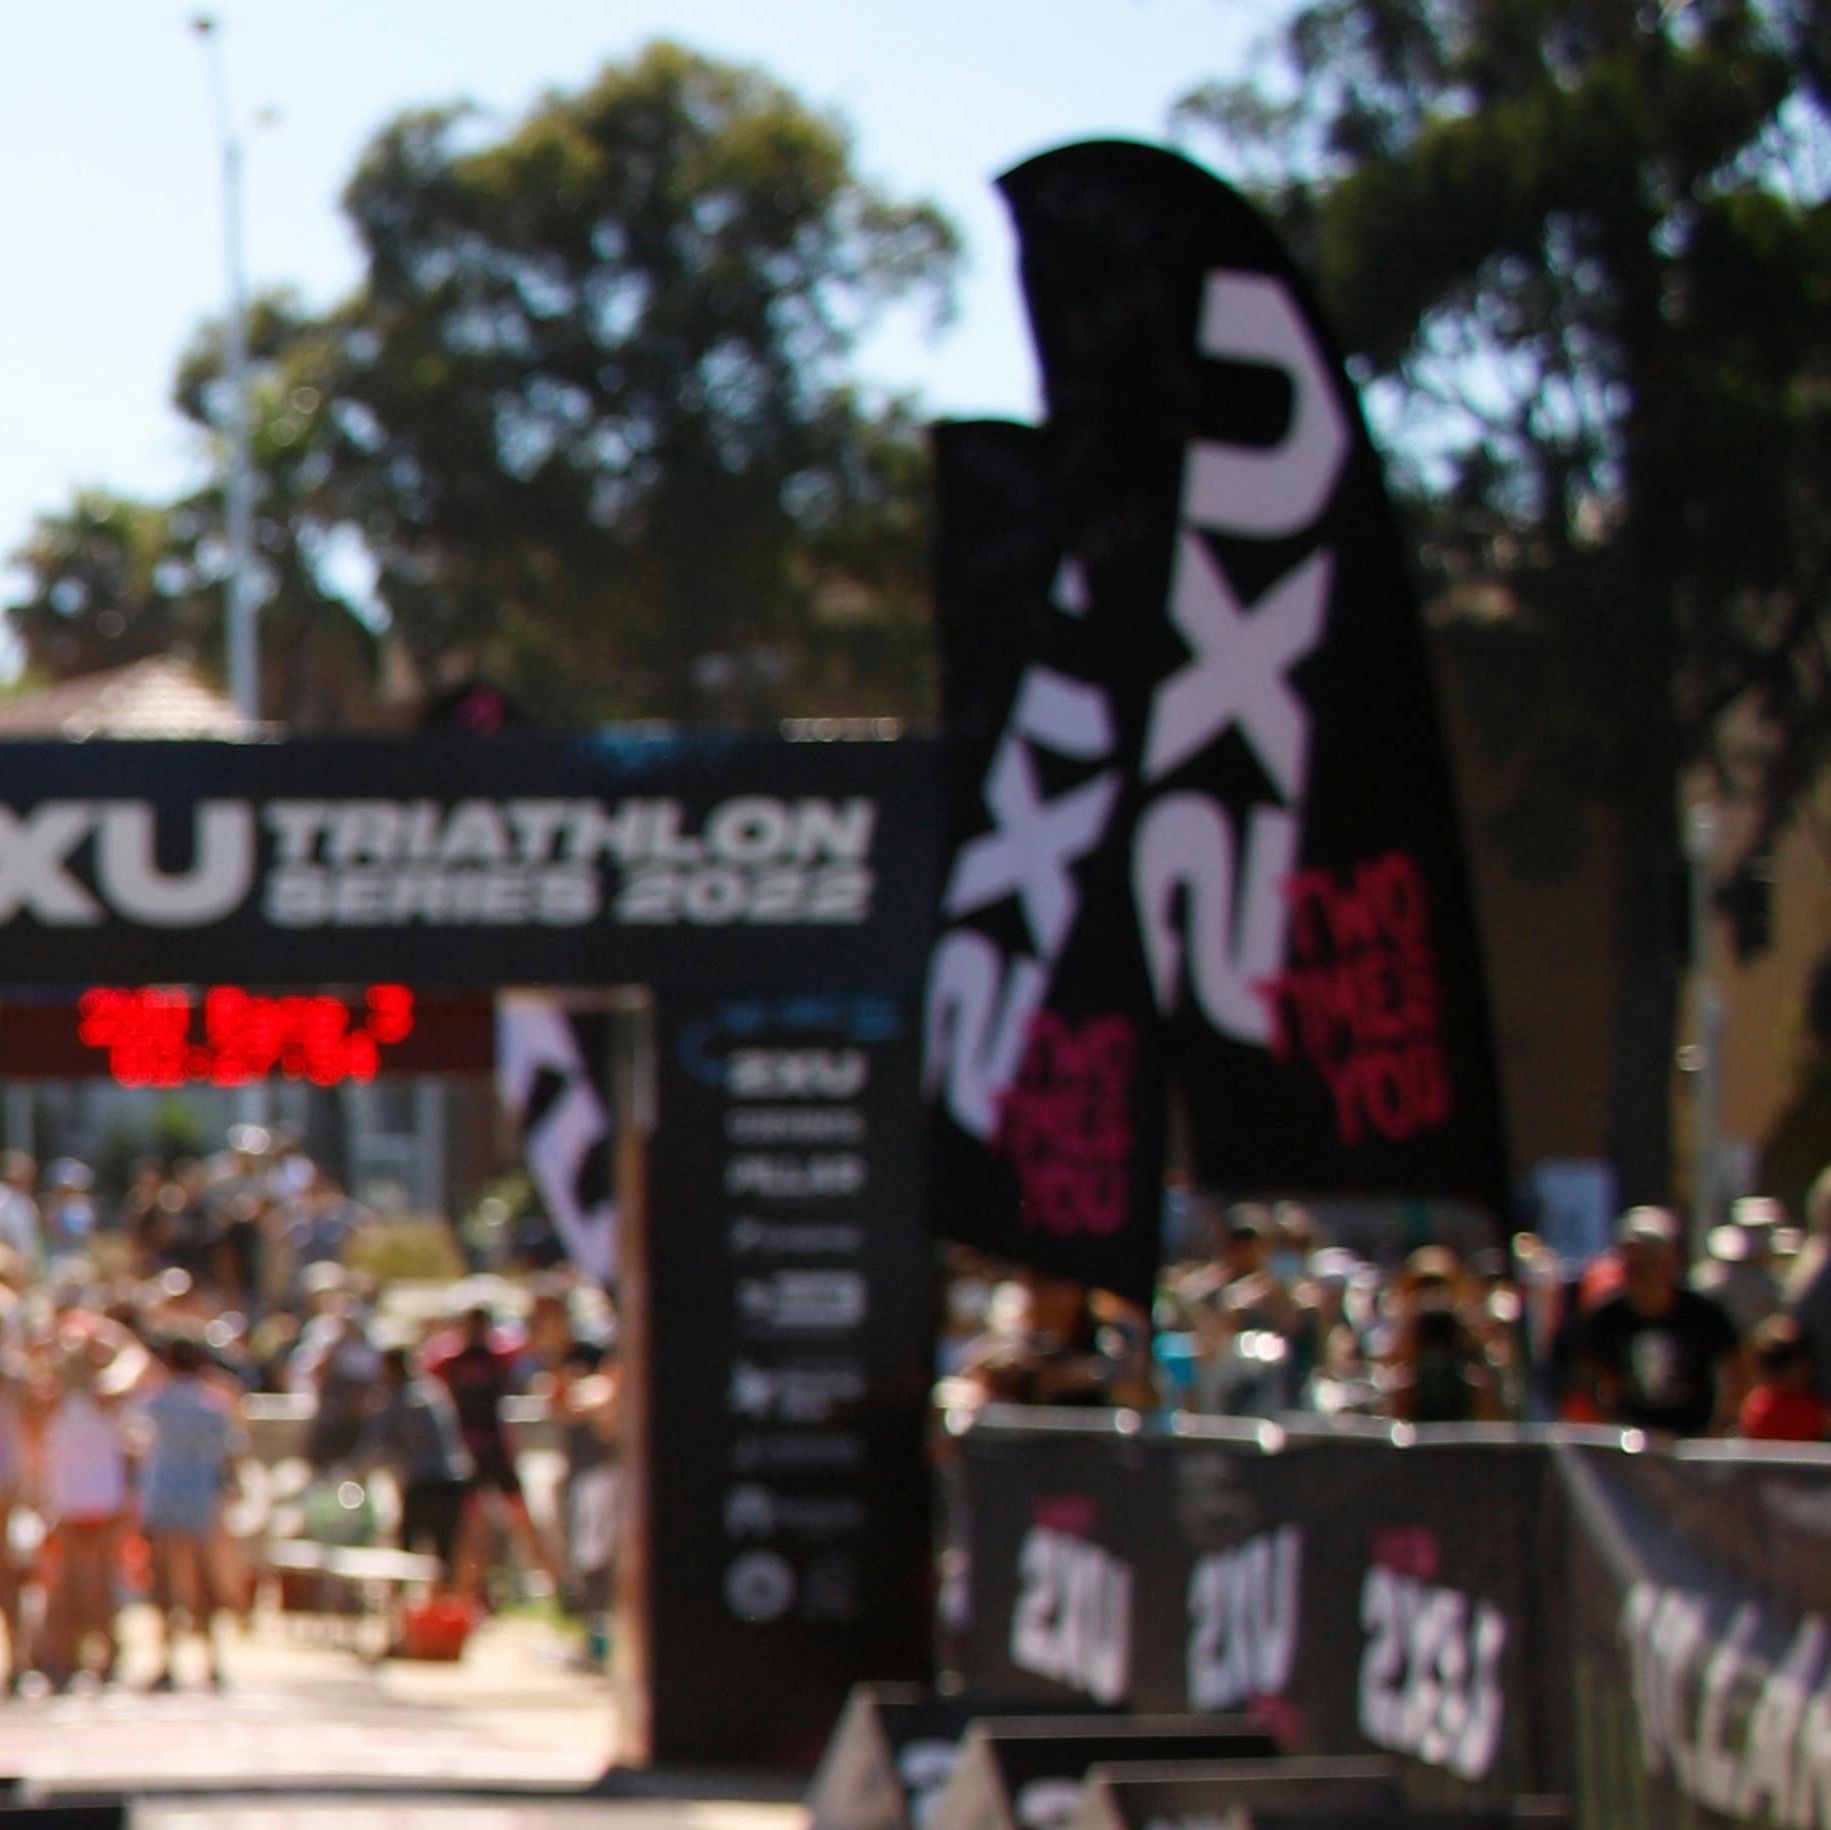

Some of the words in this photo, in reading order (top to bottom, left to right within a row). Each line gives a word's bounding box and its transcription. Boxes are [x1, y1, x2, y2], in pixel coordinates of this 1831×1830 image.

[1132, 268, 1348, 1047] 2XU
[263, 798, 876, 866] TRIATHLON
[263, 865, 599, 928] SERIES
[615, 867, 876, 928] 2022
